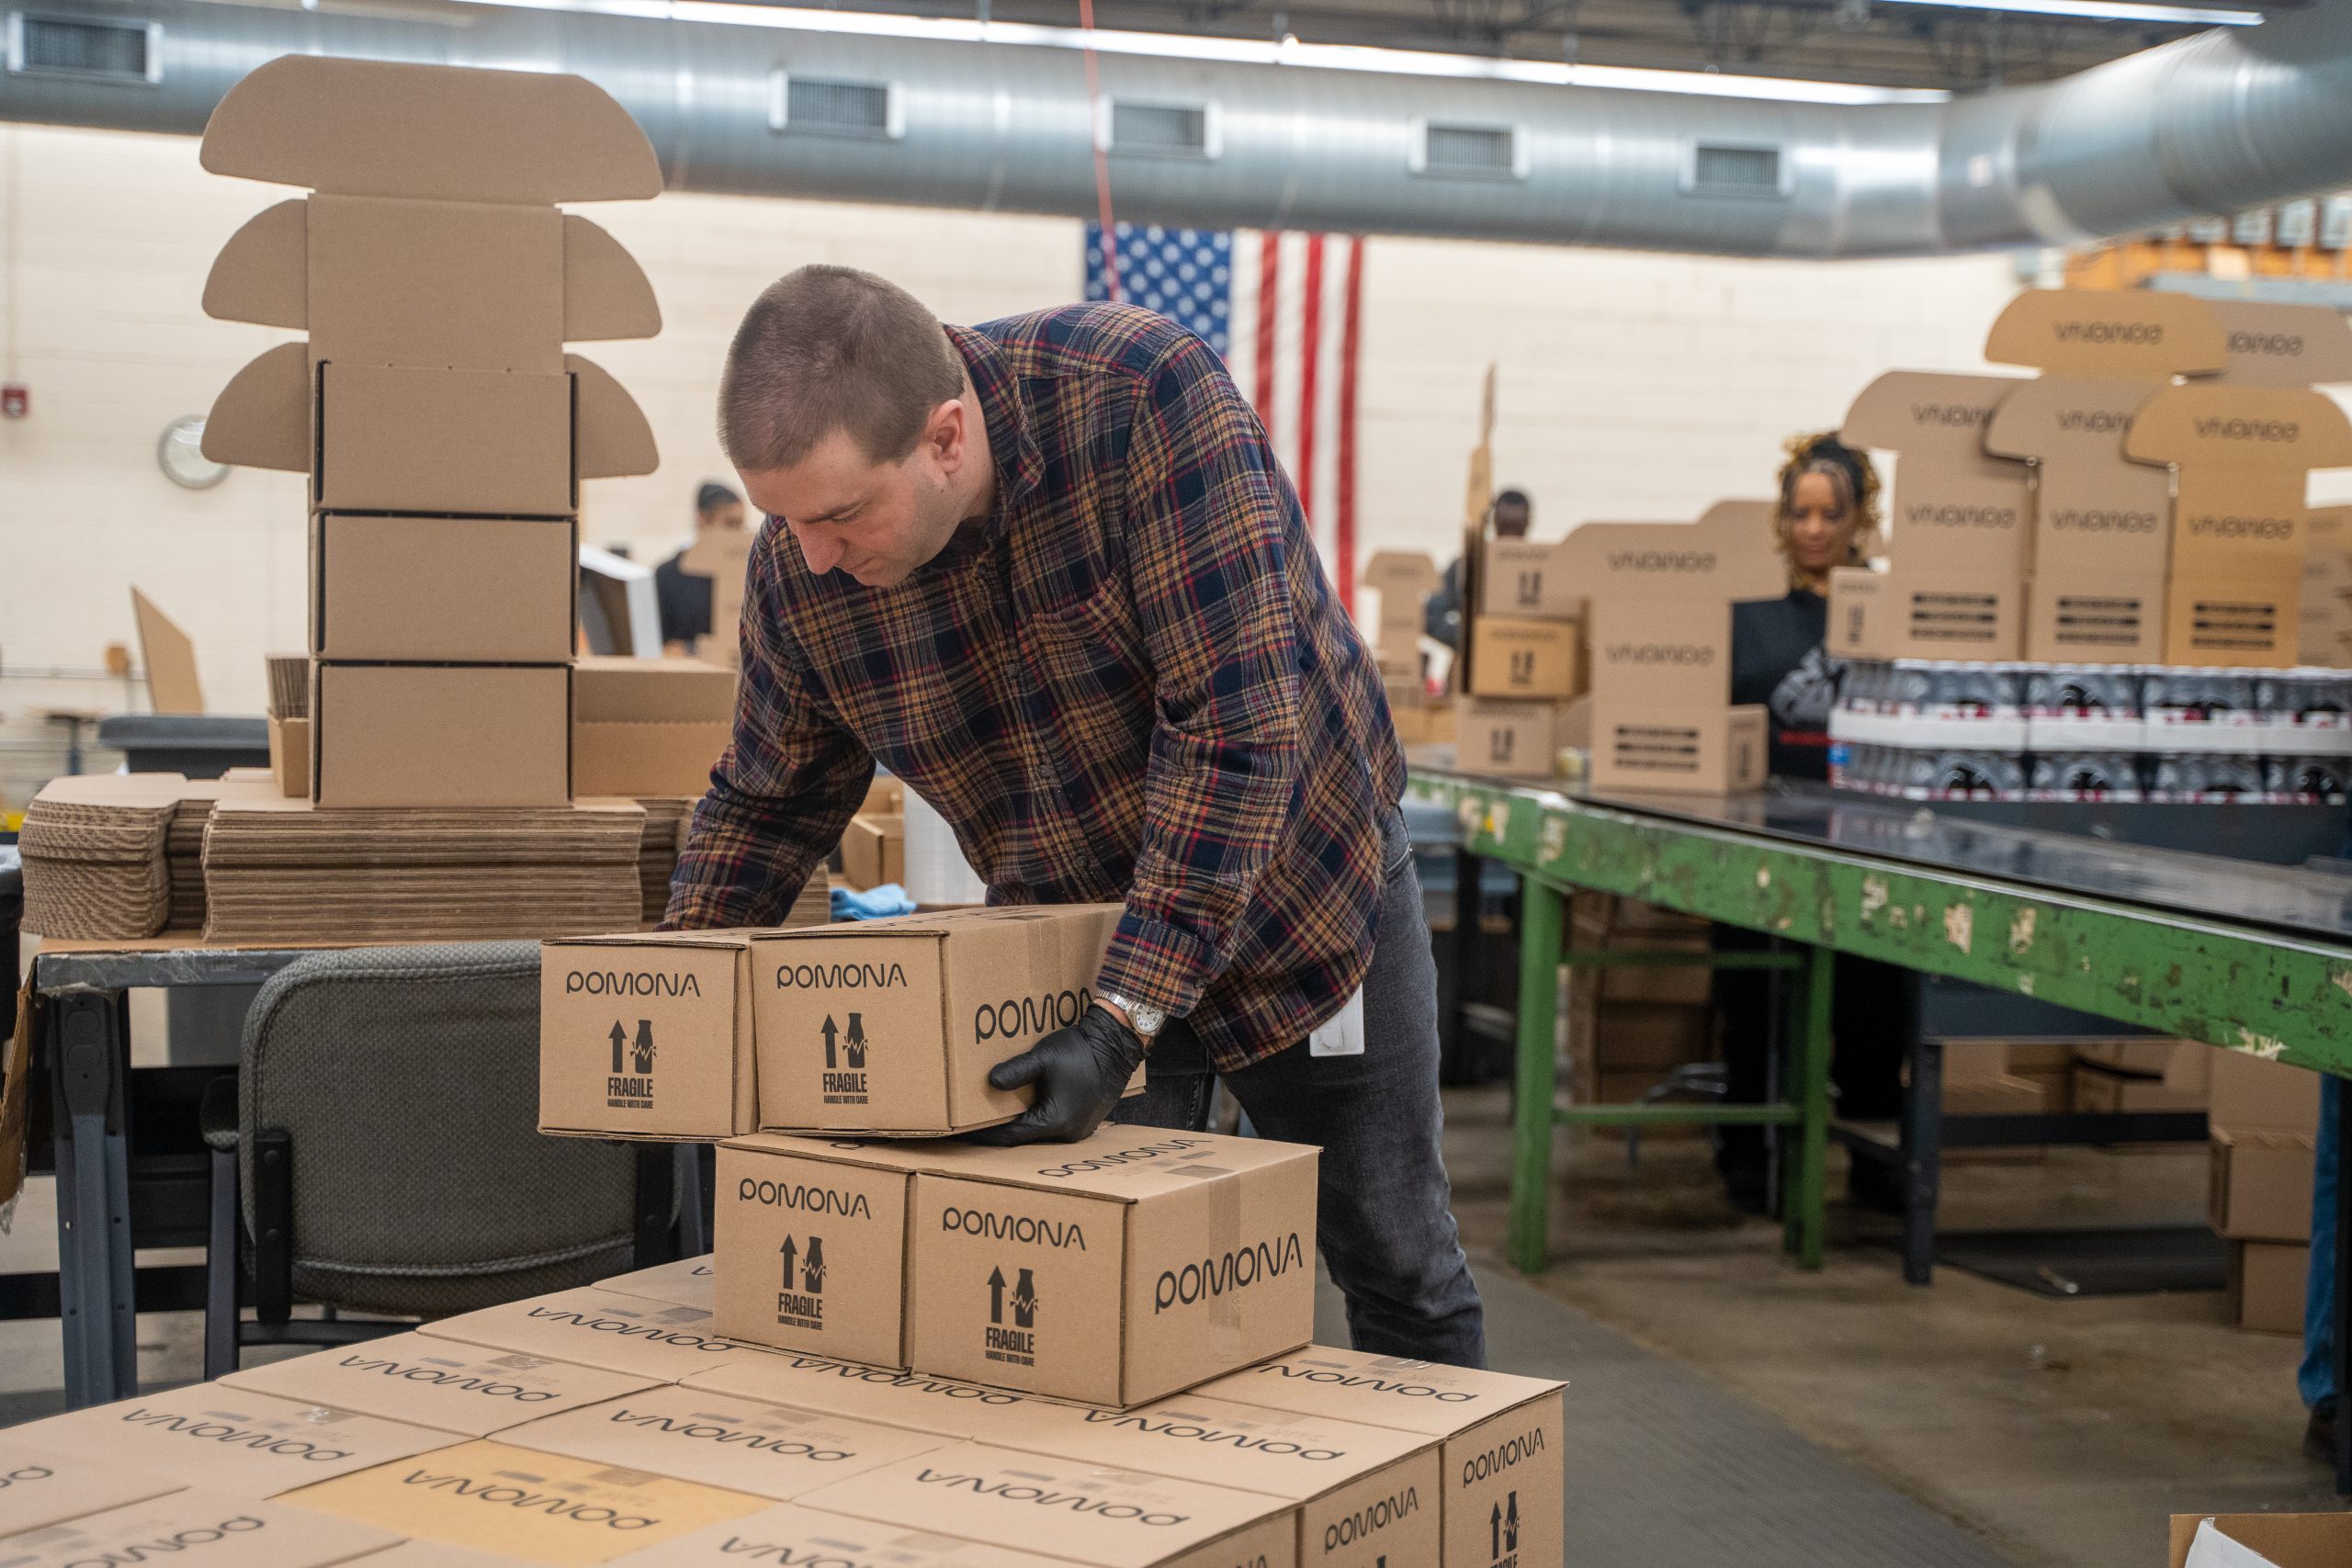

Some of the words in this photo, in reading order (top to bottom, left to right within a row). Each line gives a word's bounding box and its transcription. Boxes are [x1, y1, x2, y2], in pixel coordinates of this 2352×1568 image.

[566, 970, 700, 997] POMONA
[776, 964, 907, 988] POMONA
[975, 987, 1092, 1044] POMON
[607, 1077, 653, 1098] FRAGILE
[822, 1073, 867, 1093] FRAGILE
[1037, 1138, 1214, 1178] POMONA
[740, 1178, 871, 1220] POMONA
[943, 1207, 1086, 1251] POMONA
[1155, 1232, 1303, 1314] POMONA
[778, 1292, 822, 1319] FRAGILE
[527, 1307, 739, 1351] POMONA
[986, 1326, 1035, 1354] FRAGILE
[339, 1355, 563, 1402] POMONA
[1257, 1363, 1479, 1403] POMON
[121, 1408, 357, 1461] POMONA
[610, 1409, 857, 1461] POMONA
[1084, 1410, 1347, 1461] POMONA
[1464, 1427, 1544, 1489] POMONA
[402, 1470, 662, 1529] POMONA
[916, 1469, 1192, 1527] POMONA
[1325, 1486, 1419, 1555] POMONA
